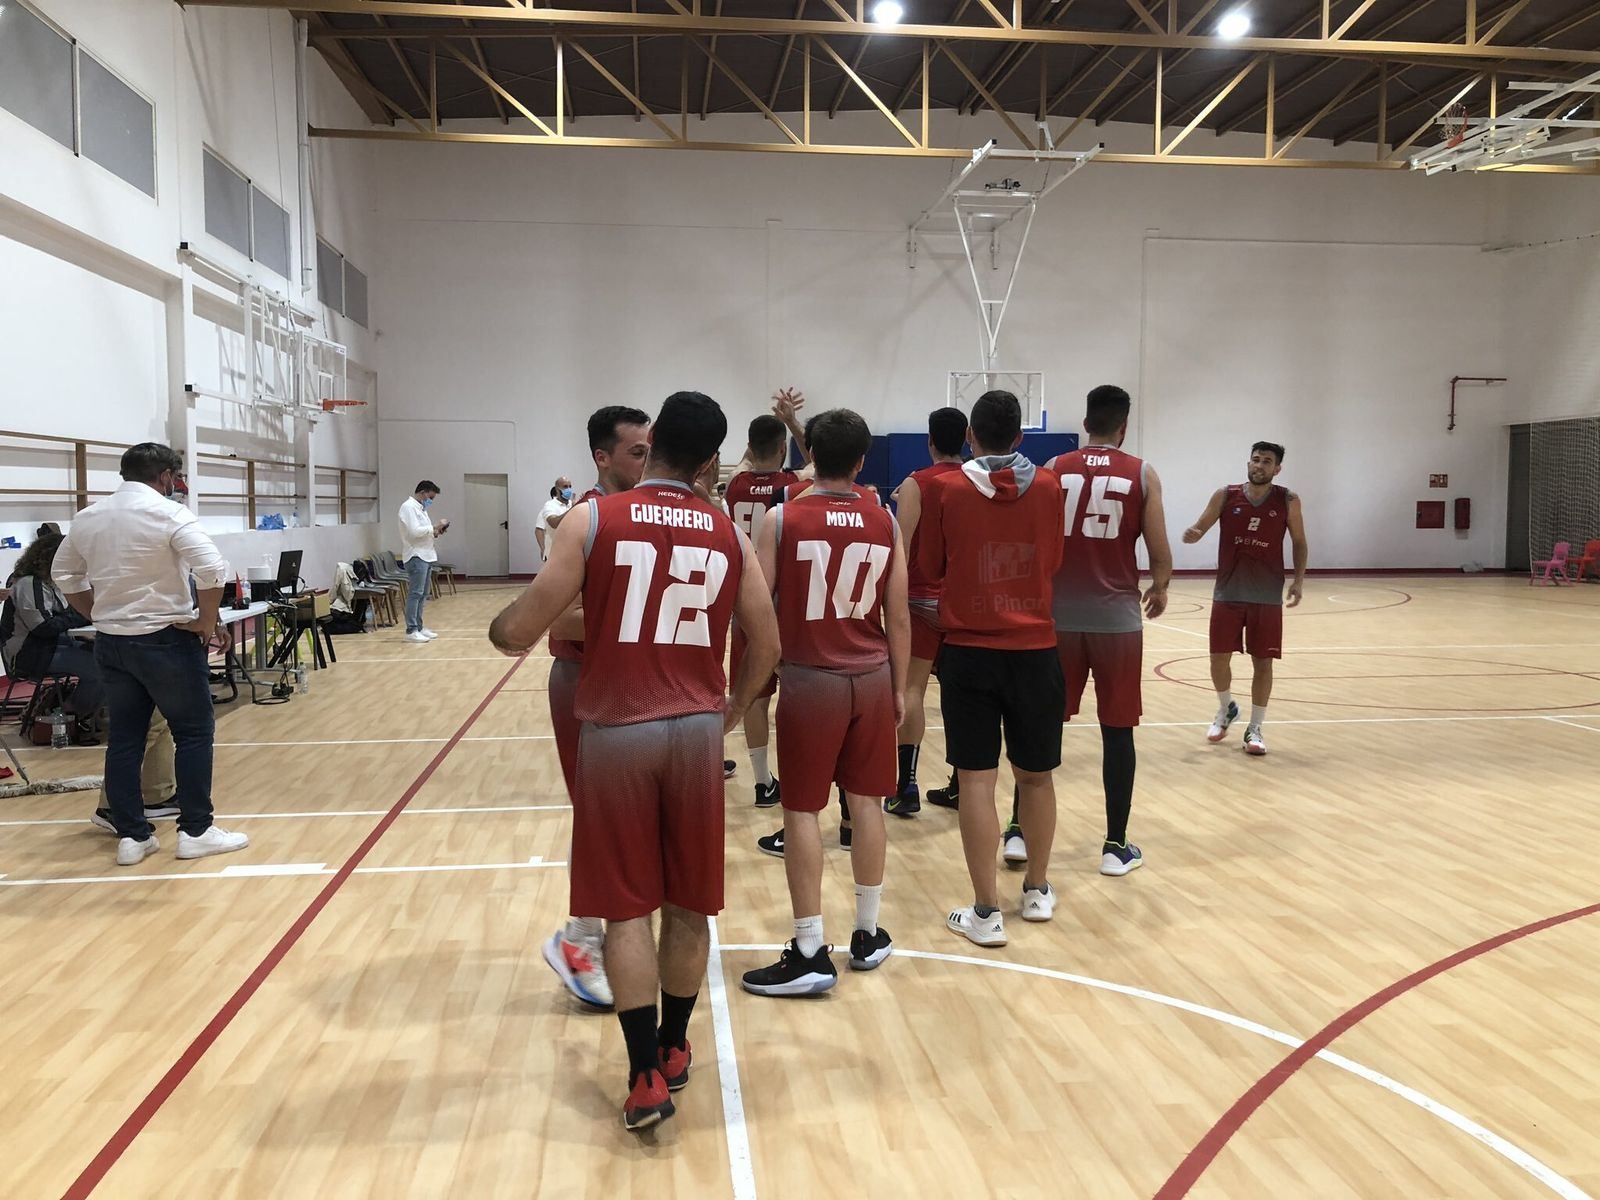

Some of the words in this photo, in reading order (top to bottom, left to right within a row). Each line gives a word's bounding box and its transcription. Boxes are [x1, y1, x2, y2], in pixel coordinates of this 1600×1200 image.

[749, 485, 773, 495] CANO
[630, 503, 714, 532] GUERRERO
[825, 510, 865, 528] MOYA
[1060, 473, 1133, 540] 15
[1247, 517, 1261, 531] 2
[614, 540, 729, 648] 12
[796, 540, 891, 620] 10
